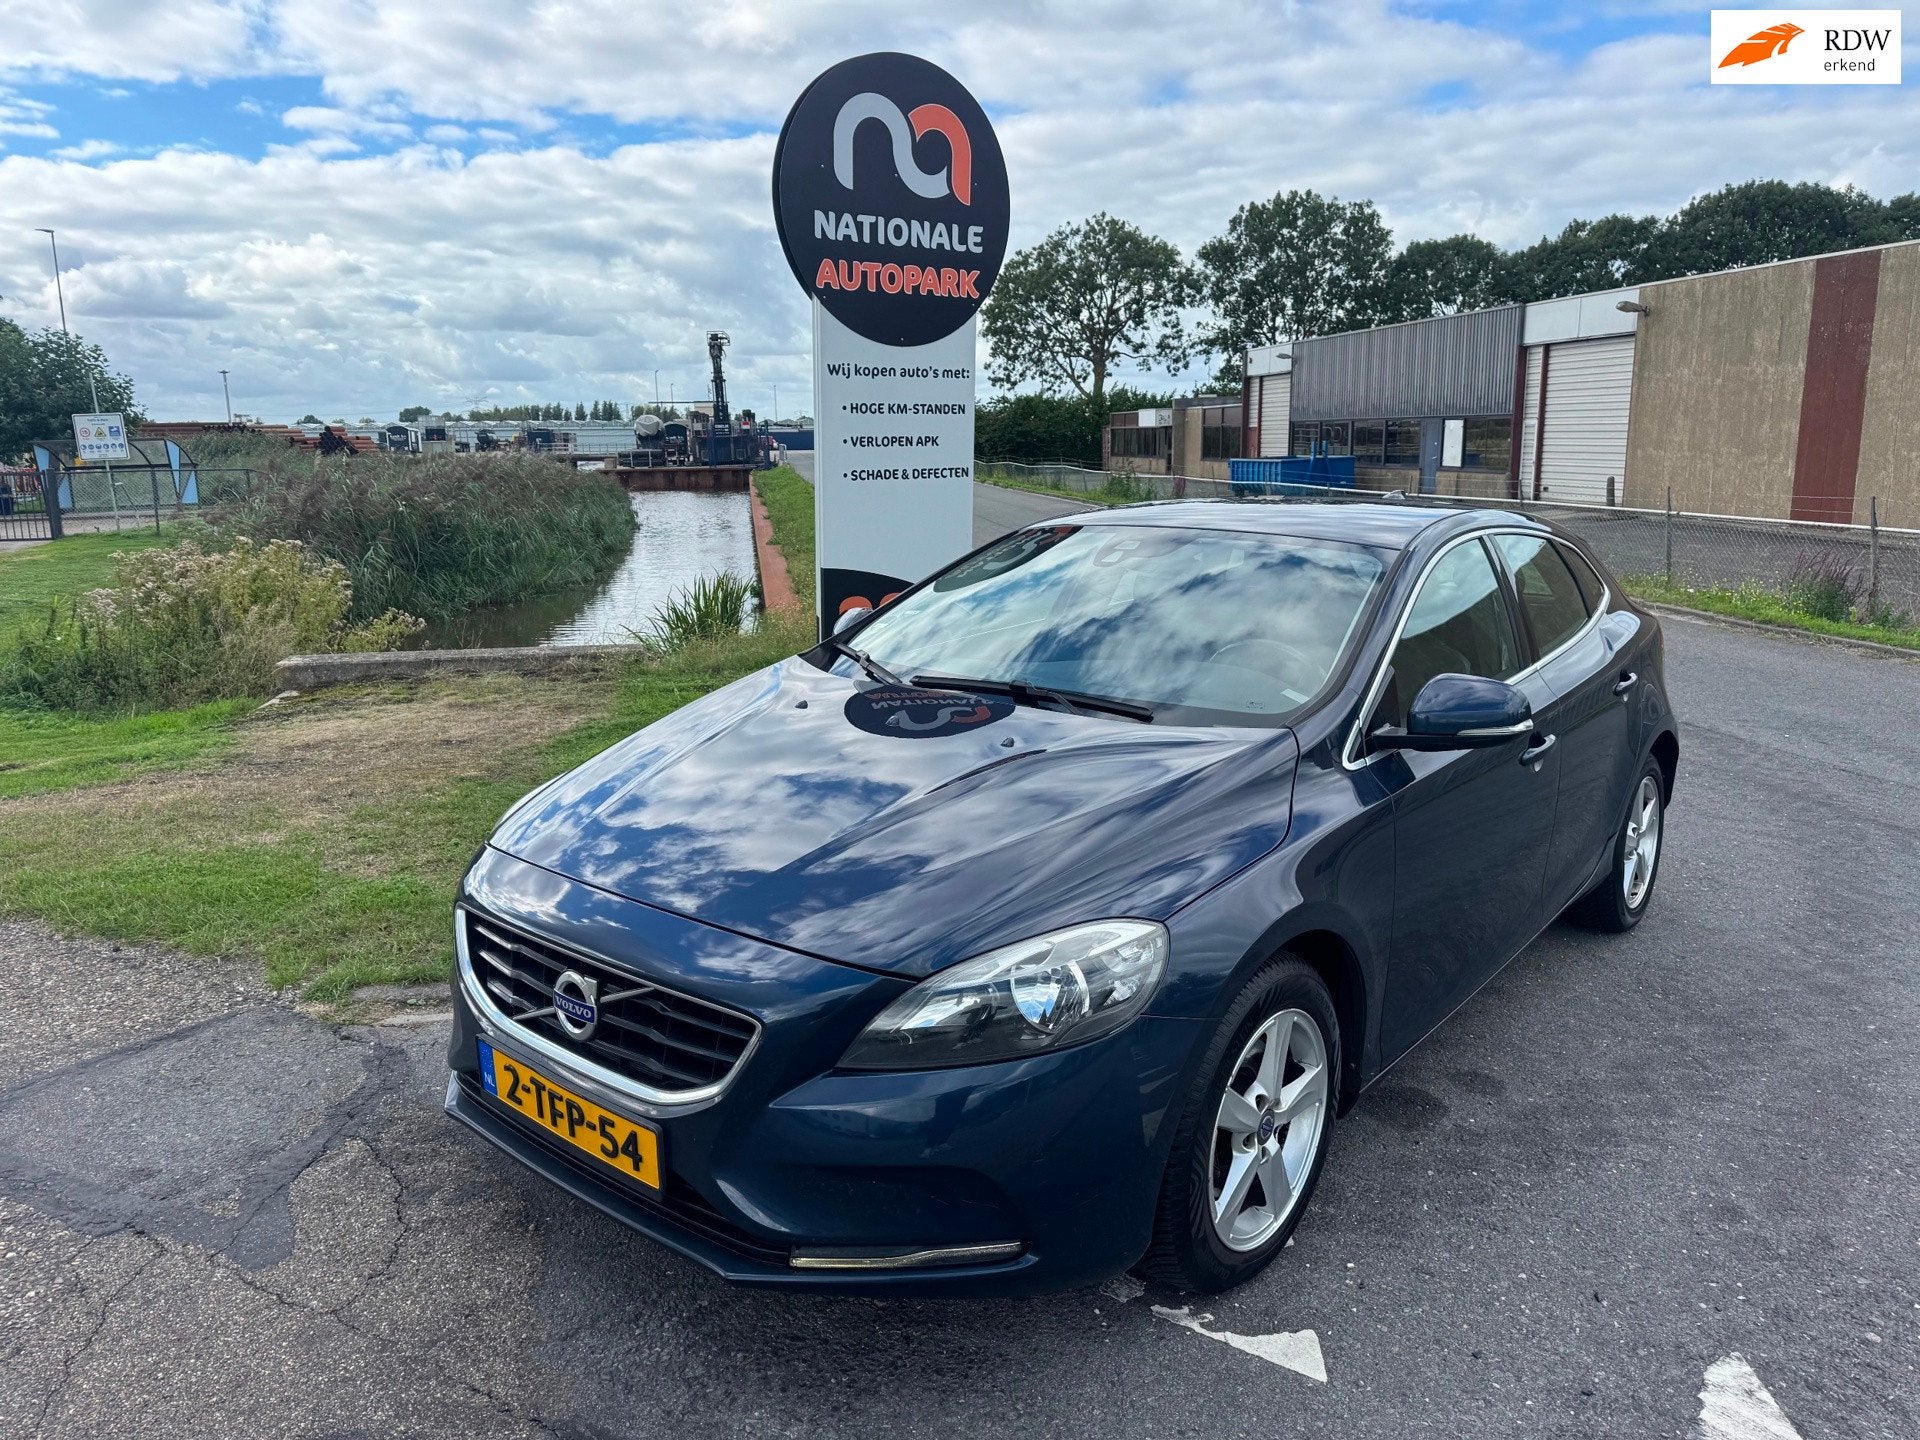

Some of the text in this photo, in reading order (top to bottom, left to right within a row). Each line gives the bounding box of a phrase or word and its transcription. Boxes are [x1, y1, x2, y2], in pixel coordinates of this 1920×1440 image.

[814, 209, 984, 254] NATIONALE
[815, 258, 981, 299] AUTOPARK
[827, 363, 970, 380] Wij kopen auto's met:
[850, 402, 966, 415] HOGE KM-STANDEN
[851, 435, 939, 448] VERLOPEN APK
[850, 467, 969, 481] SCHADE & DEFECTEN
[555, 995, 592, 1019] VOLVO
[484, 1071, 495, 1088] NL
[504, 1063, 643, 1172] 2-TFP-54
